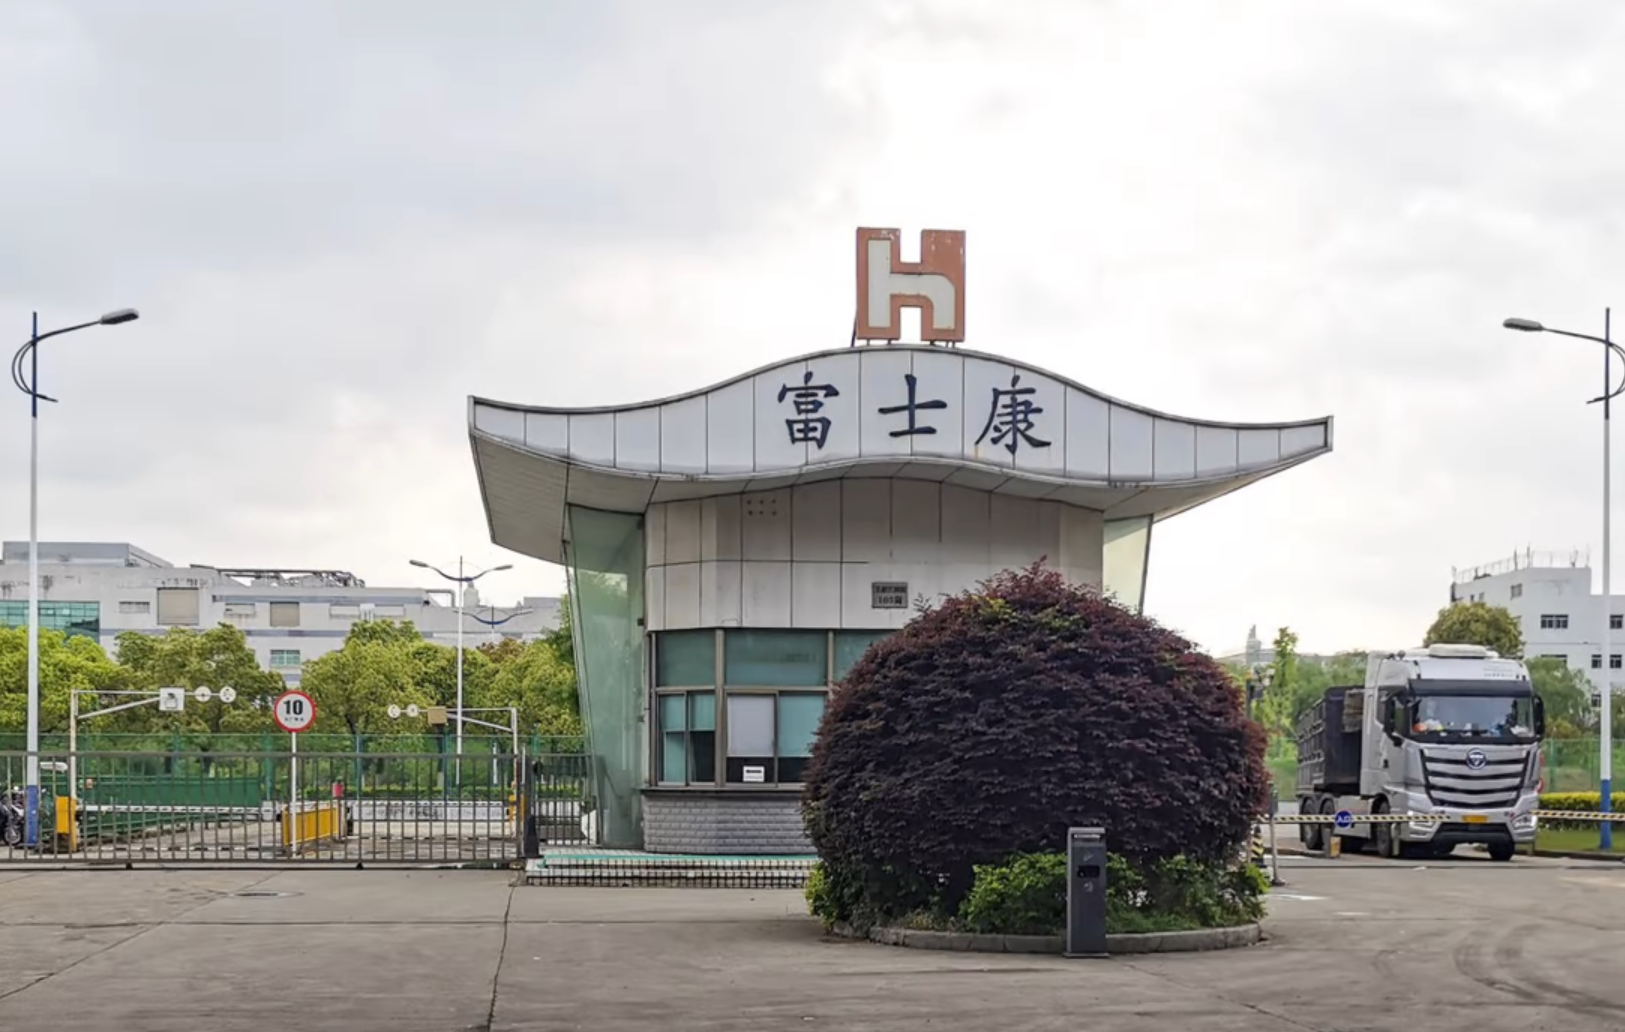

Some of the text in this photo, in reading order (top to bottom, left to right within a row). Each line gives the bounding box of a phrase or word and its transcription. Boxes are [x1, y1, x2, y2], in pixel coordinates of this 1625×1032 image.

[777, 371, 1052, 455] 富士康
[283, 700, 303, 715] 10
